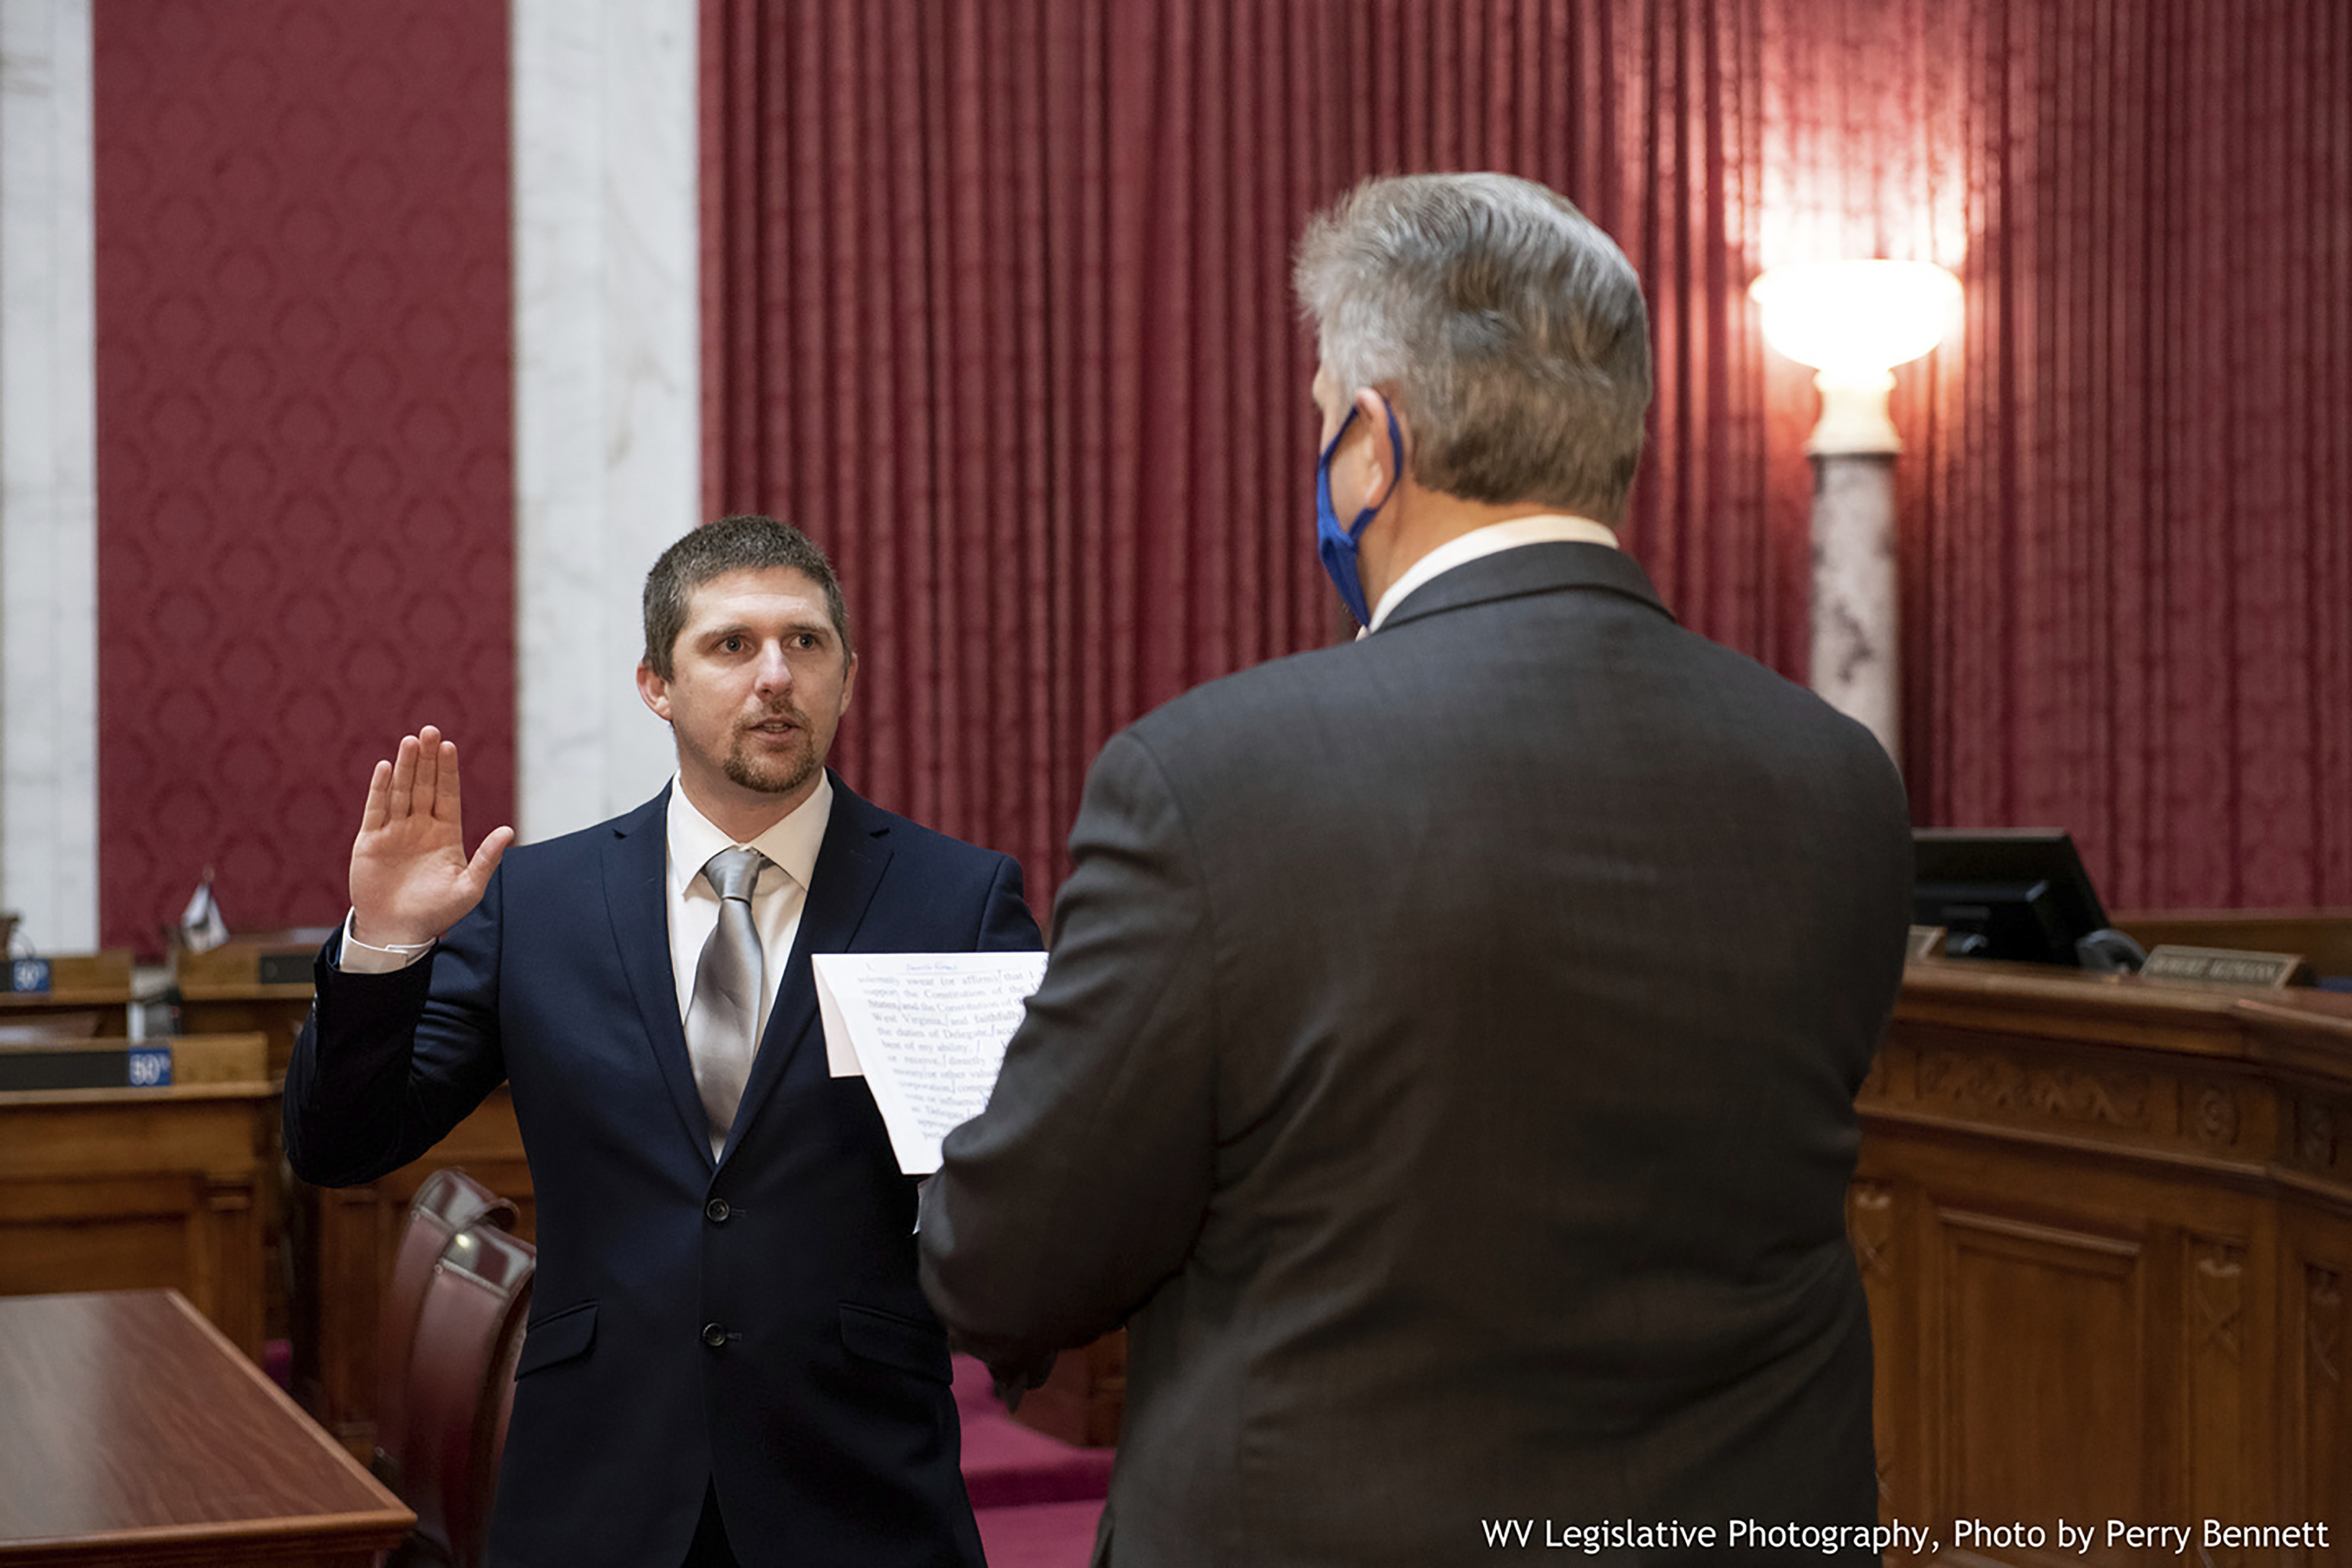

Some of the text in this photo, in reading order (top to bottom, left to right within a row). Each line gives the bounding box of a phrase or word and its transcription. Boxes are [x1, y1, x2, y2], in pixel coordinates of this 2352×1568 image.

[1003, 973, 1023, 981] that
[904, 989, 918, 997] the
[924, 990, 986, 999] Constitution
[902, 1002, 919, 1011] and
[920, 1003, 935, 1011] the
[937, 1003, 999, 1012] Constitution
[871, 1013, 897, 1023] West
[950, 1016, 969, 1025] and
[877, 1027, 892, 1036] the
[896, 1029, 925, 1038] duties
[928, 1030, 939, 1038] of
[881, 1039, 902, 1049] best
[904, 1041, 915, 1051] of
[918, 1045, 932, 1054] my
